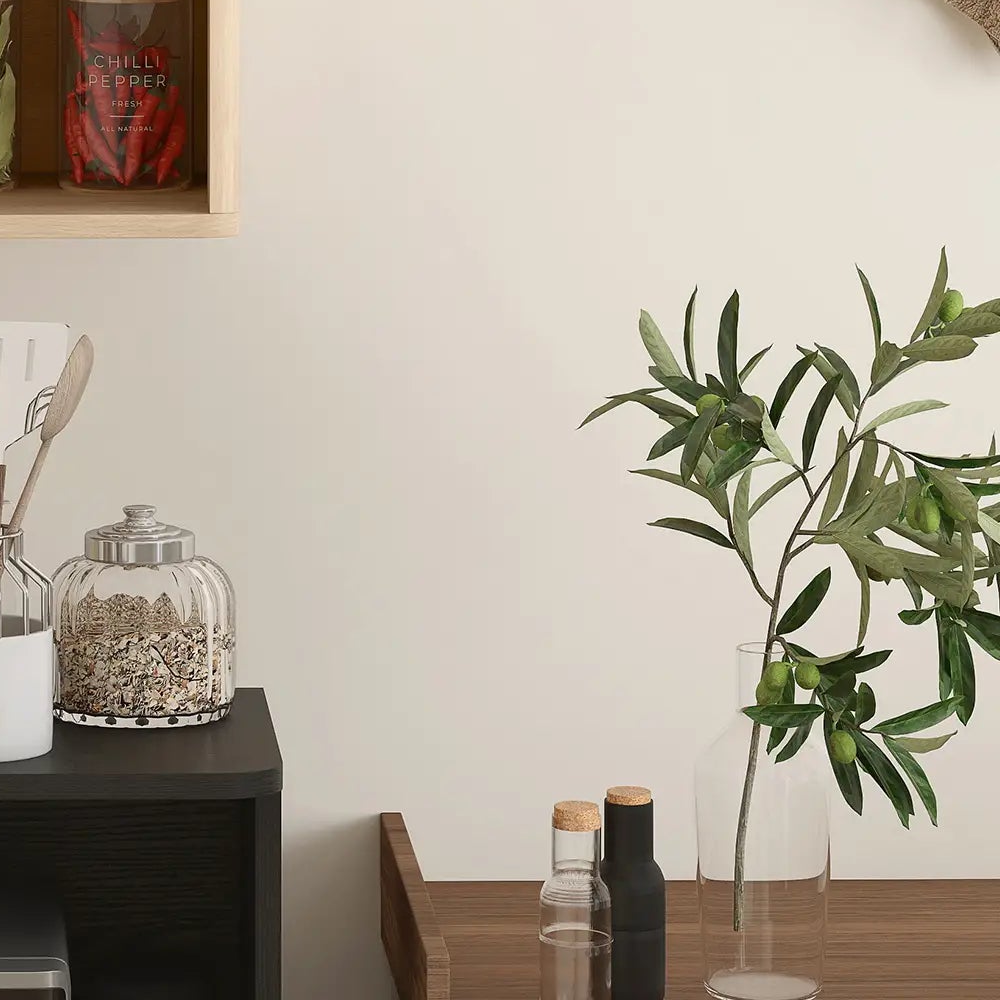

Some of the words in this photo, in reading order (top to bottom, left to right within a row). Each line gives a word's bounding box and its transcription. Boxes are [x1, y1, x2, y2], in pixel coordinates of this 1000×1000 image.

[93, 55, 159, 68] CHILLI
[88, 74, 167, 88] PEPPER
[111, 100, 143, 108] FRESH
